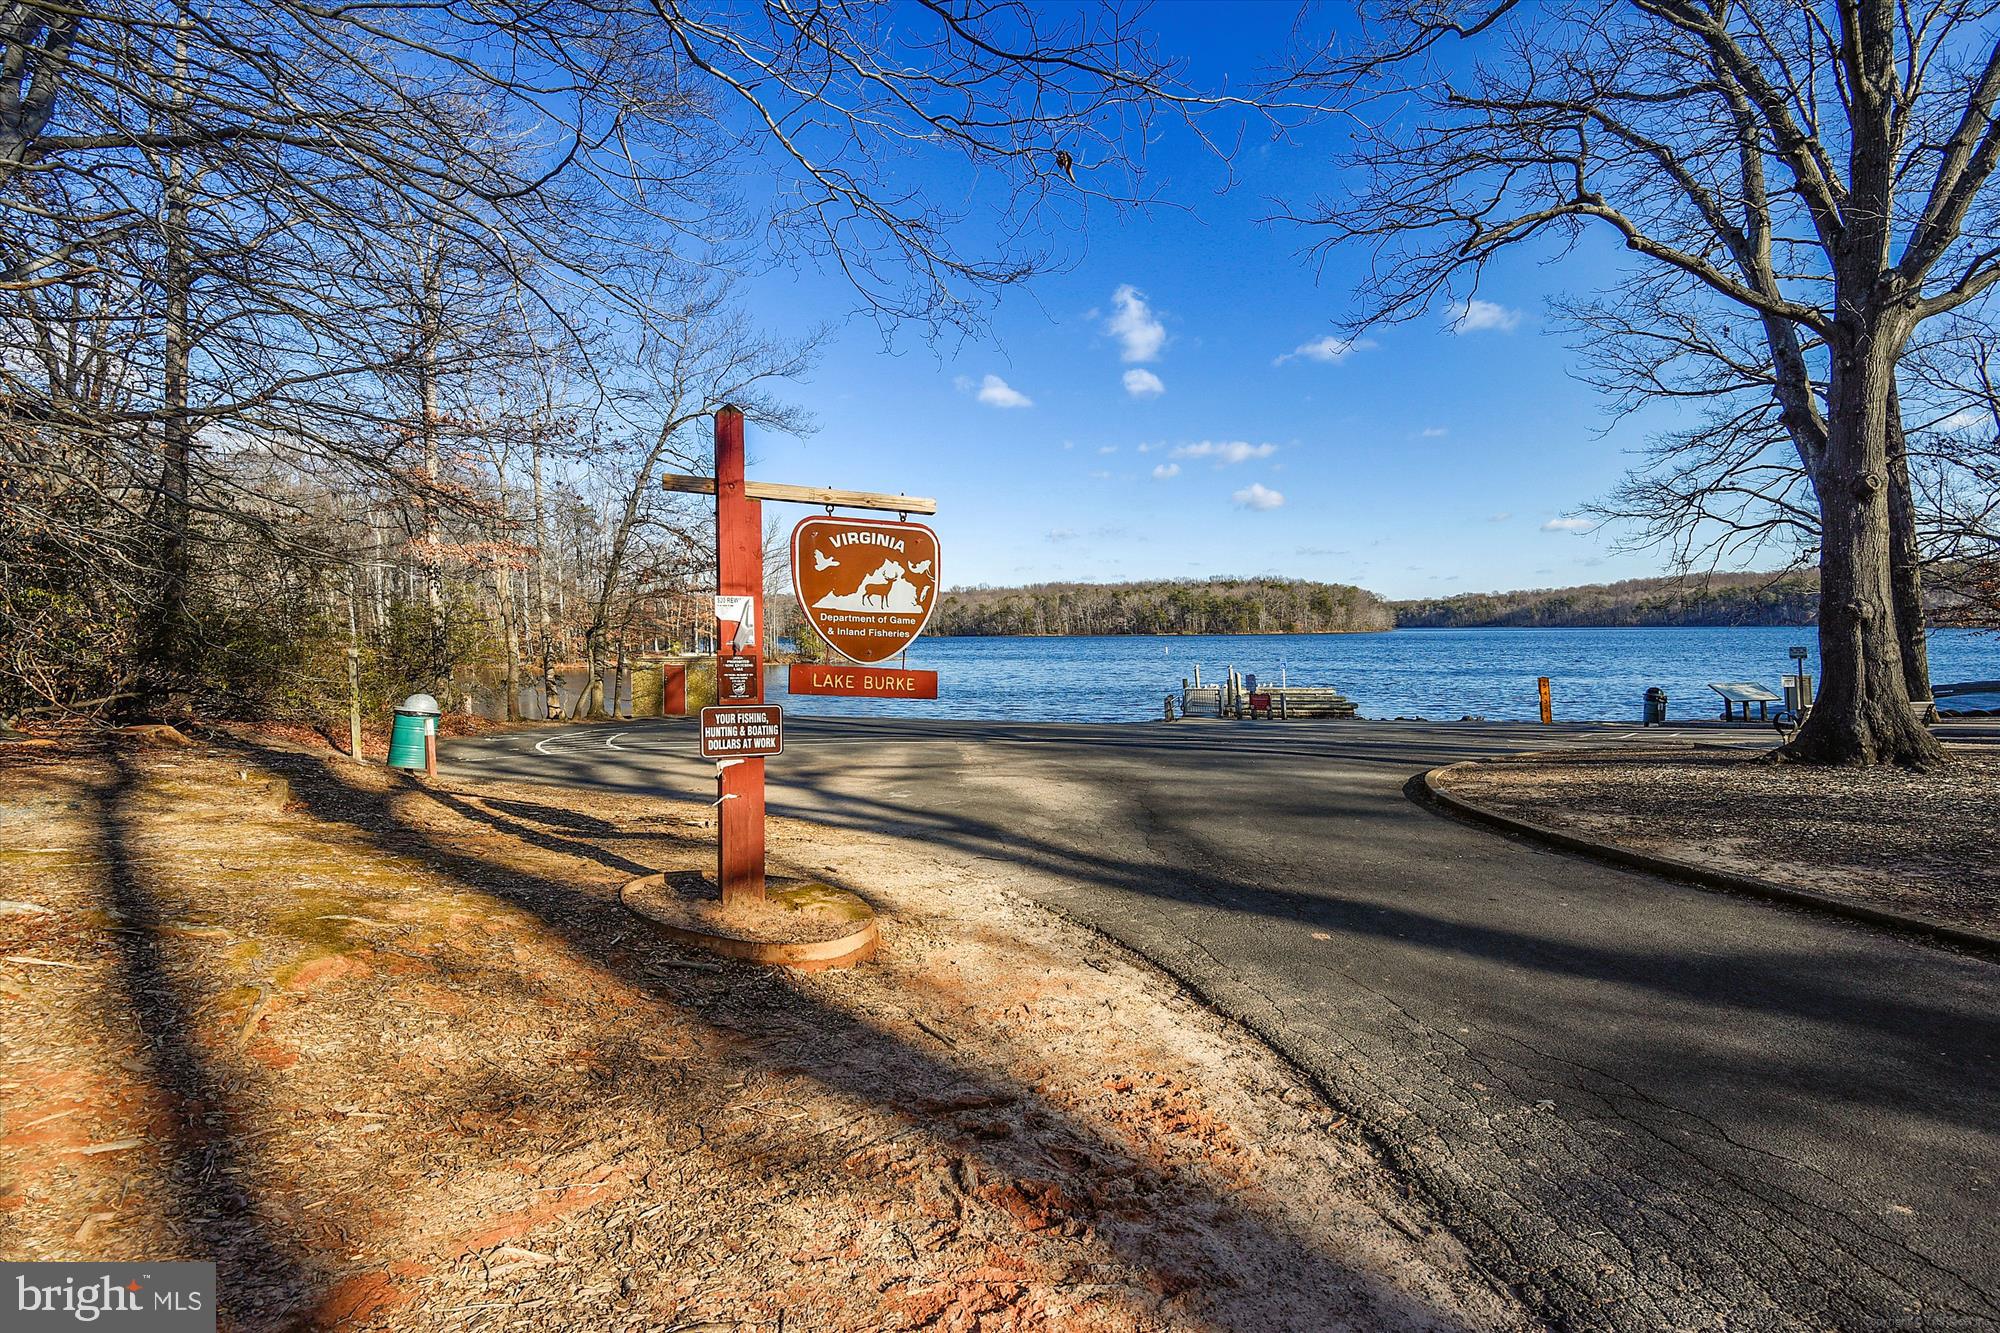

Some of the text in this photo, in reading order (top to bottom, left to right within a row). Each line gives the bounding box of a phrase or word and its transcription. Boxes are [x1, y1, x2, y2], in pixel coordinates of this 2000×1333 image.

[829, 532, 905, 553] VIRGINIA
[820, 613, 916, 625] Department of Game
[827, 627, 910, 638] & Inland Fisheries
[813, 673, 916, 691] LAKE BURKE
[715, 713, 769, 724] YOUR FISHING,
[705, 725, 779, 737] HUNTING & BOATING
[708, 737, 776, 750] DOLLARS AT WORK
